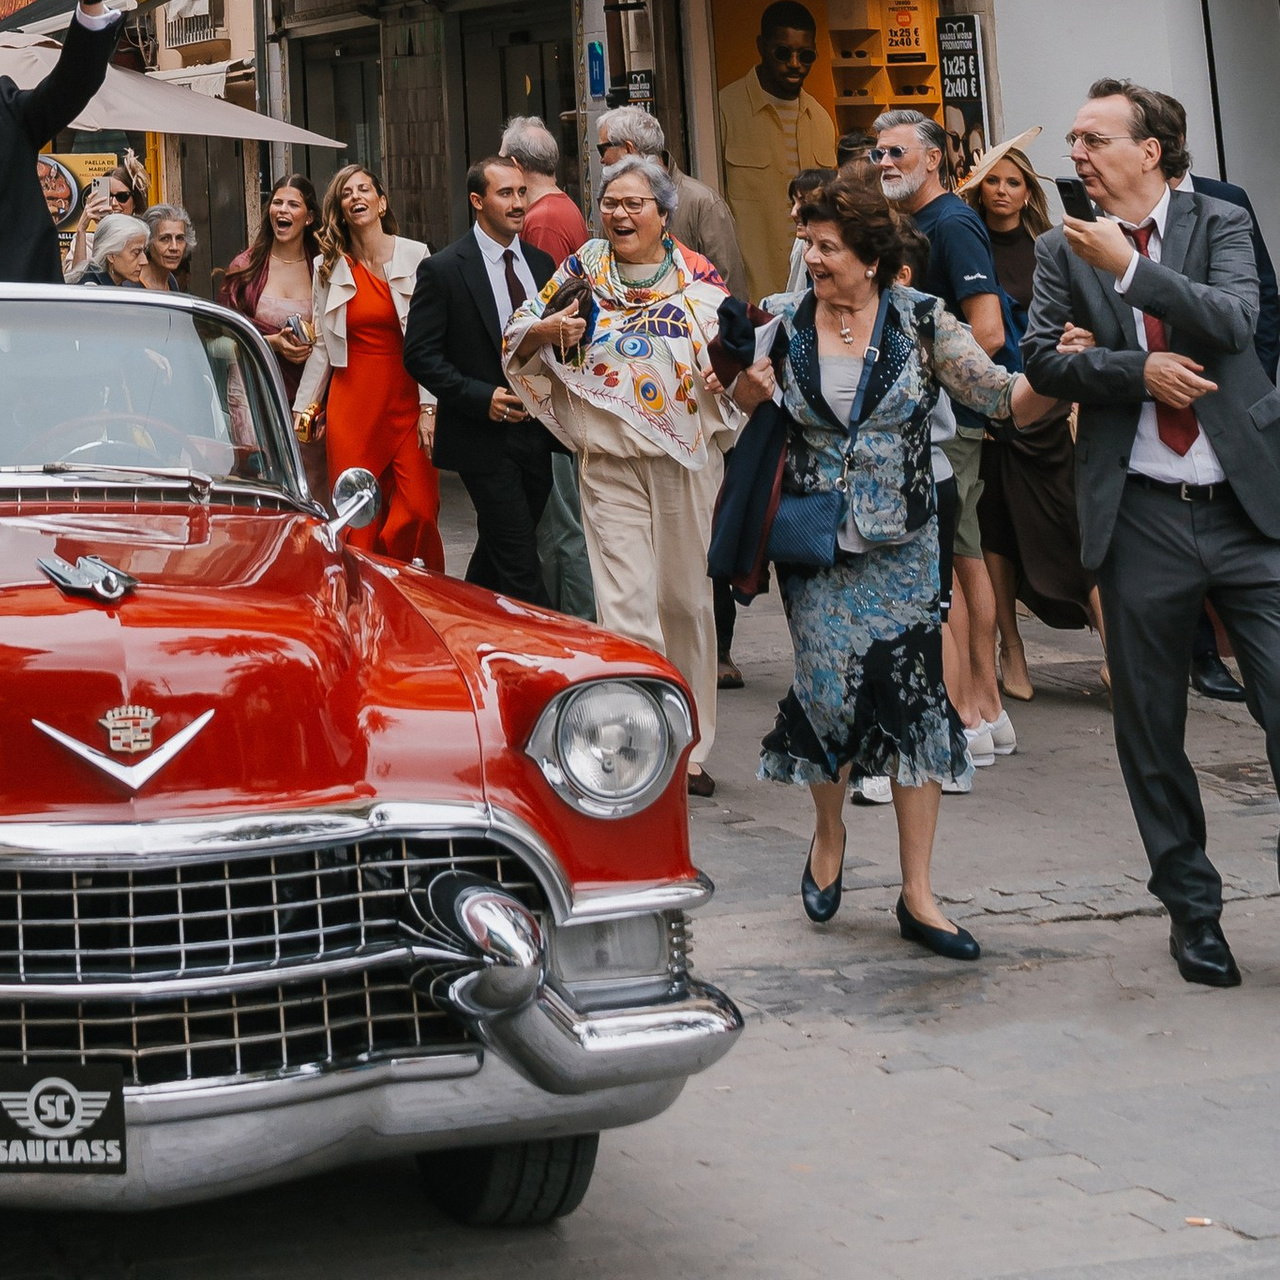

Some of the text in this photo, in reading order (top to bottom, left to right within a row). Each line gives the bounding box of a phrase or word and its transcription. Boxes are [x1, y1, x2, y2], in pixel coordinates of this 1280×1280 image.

[888, 27, 920, 37] 1x25 €
[888, 37, 920, 47] 2x40 €
[942, 56, 976, 76] 1x25 €
[944, 77, 978, 98] 2x40 €
[39, 1095, 71, 1122] SC
